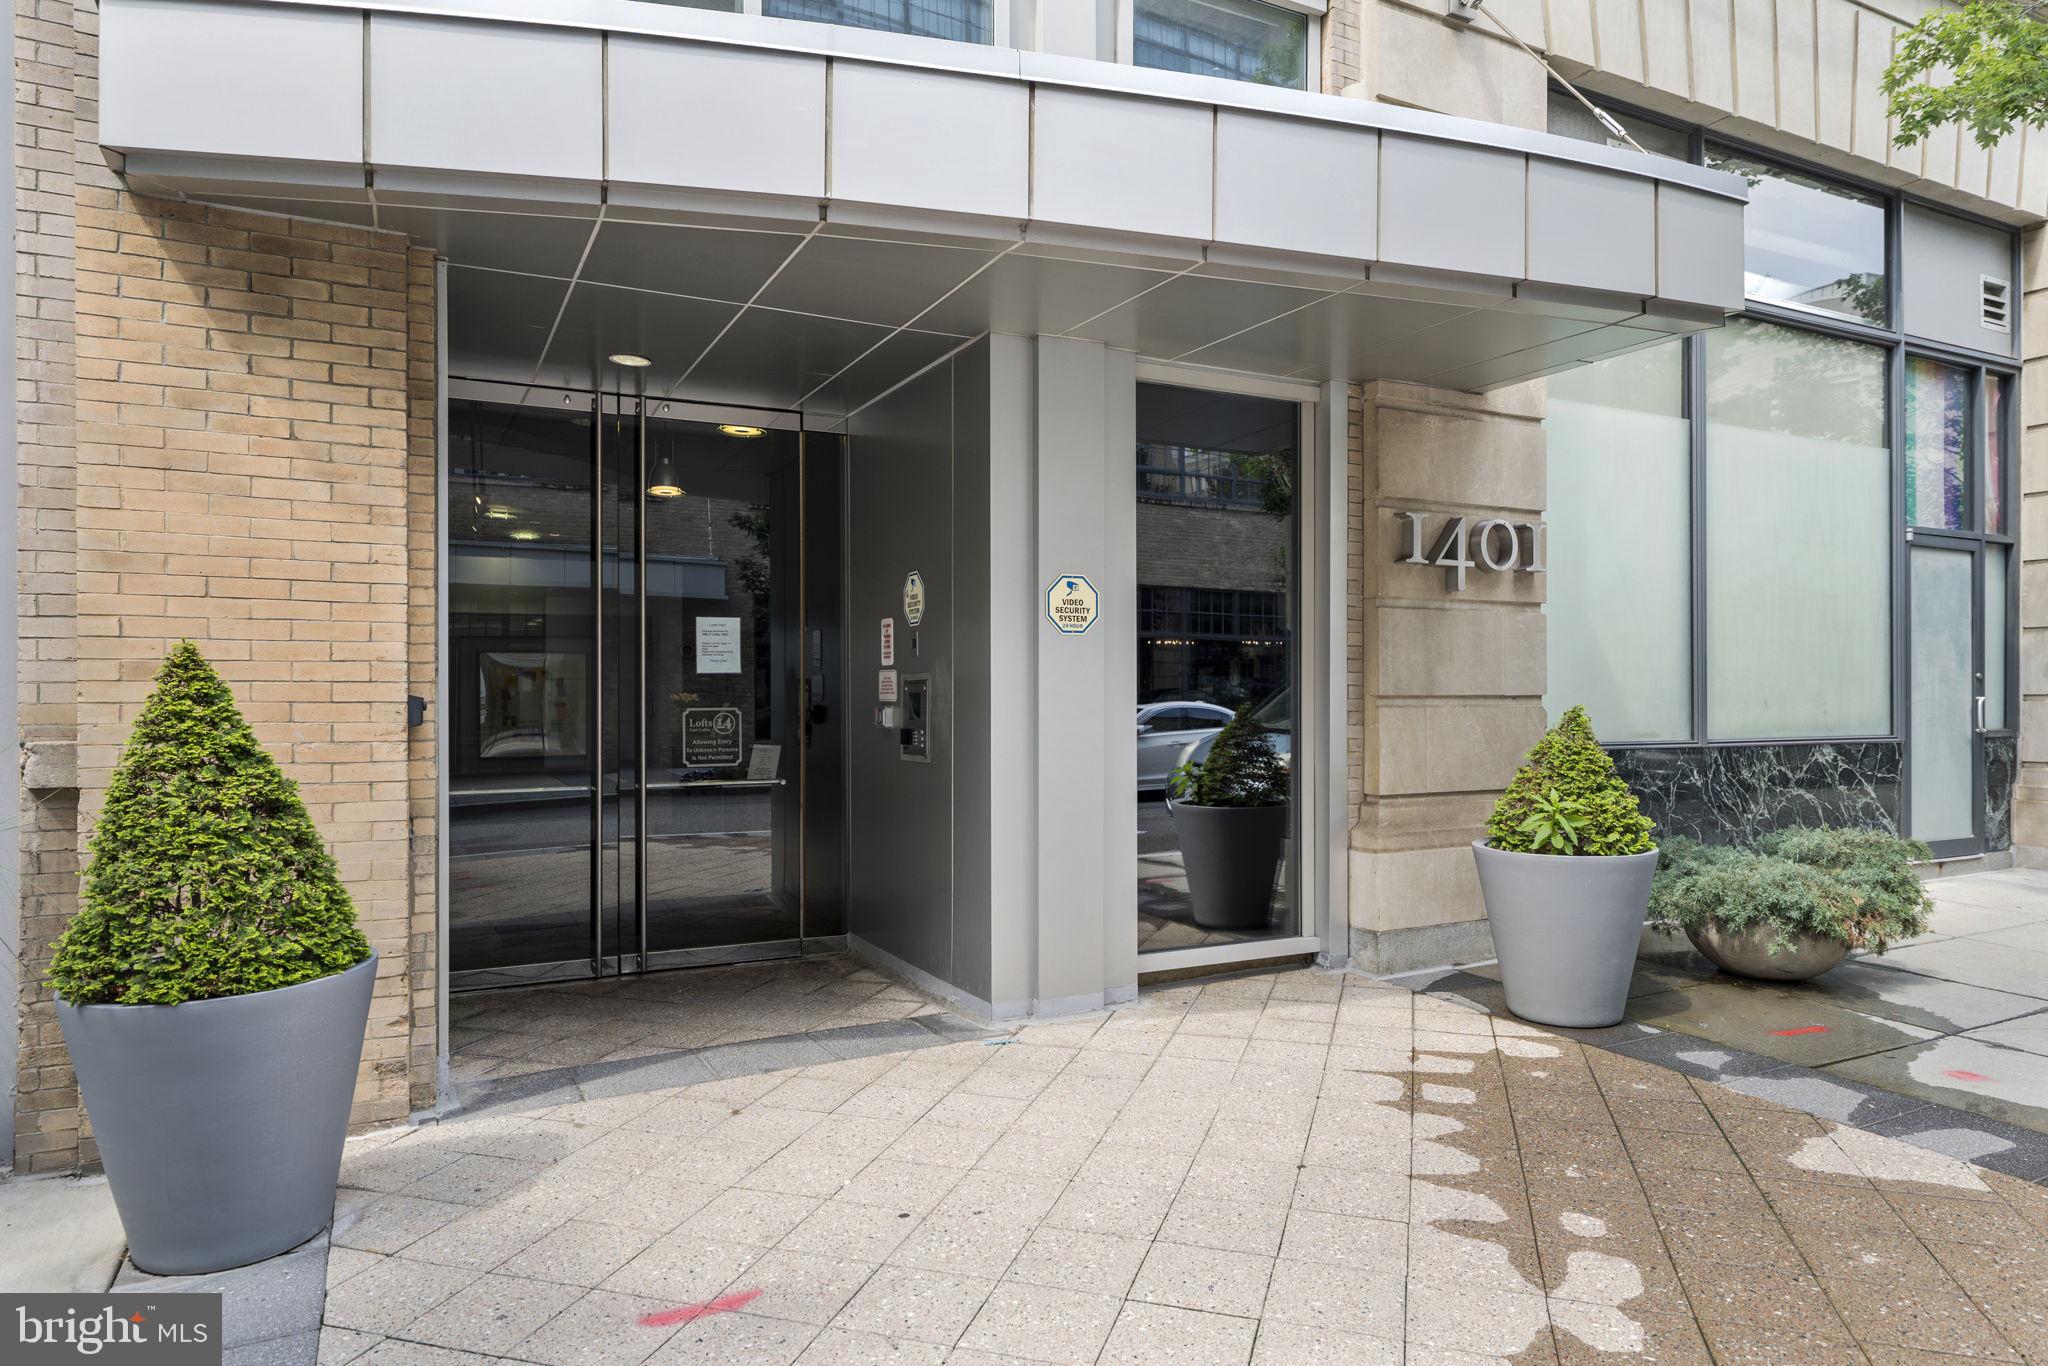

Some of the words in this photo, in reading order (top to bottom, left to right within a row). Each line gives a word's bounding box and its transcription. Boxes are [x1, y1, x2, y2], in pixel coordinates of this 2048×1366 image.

[1394, 511, 1547, 592] 1401
[1062, 598, 1084, 606] VIDEO
[1055, 606, 1090, 614] SECURITY
[689, 718, 713, 728] Lofts
